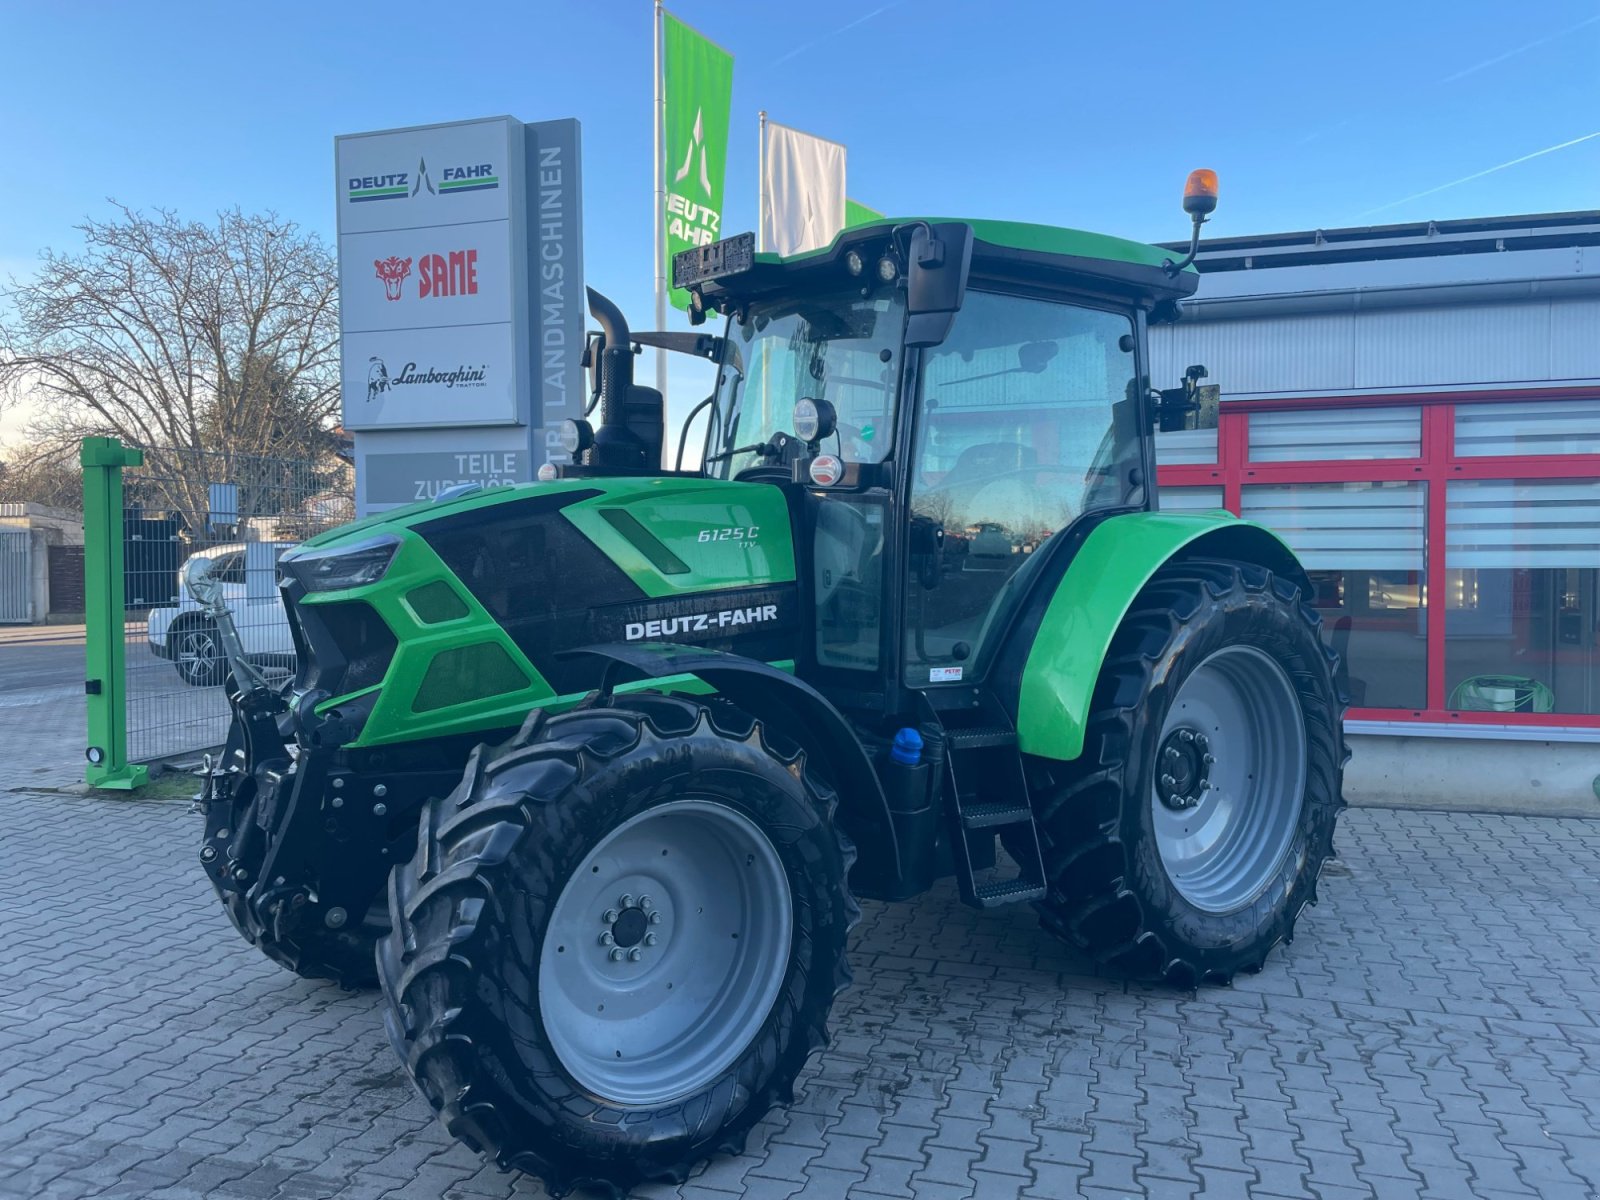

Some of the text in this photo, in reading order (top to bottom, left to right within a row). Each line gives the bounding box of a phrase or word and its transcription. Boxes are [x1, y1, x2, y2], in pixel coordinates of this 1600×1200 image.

[349, 164, 492, 190] DEUTZ FAHR
[666, 191, 720, 232] EUTZ
[669, 216, 713, 247] AHR
[418, 249, 478, 299] SAME
[540, 146, 566, 406] LANDMASCHINEN
[391, 362, 486, 388] Lamborghini
[454, 453, 516, 474] TEILE
[698, 526, 760, 543] 6125 C
[625, 605, 777, 640] DEUTZ-FAHR
